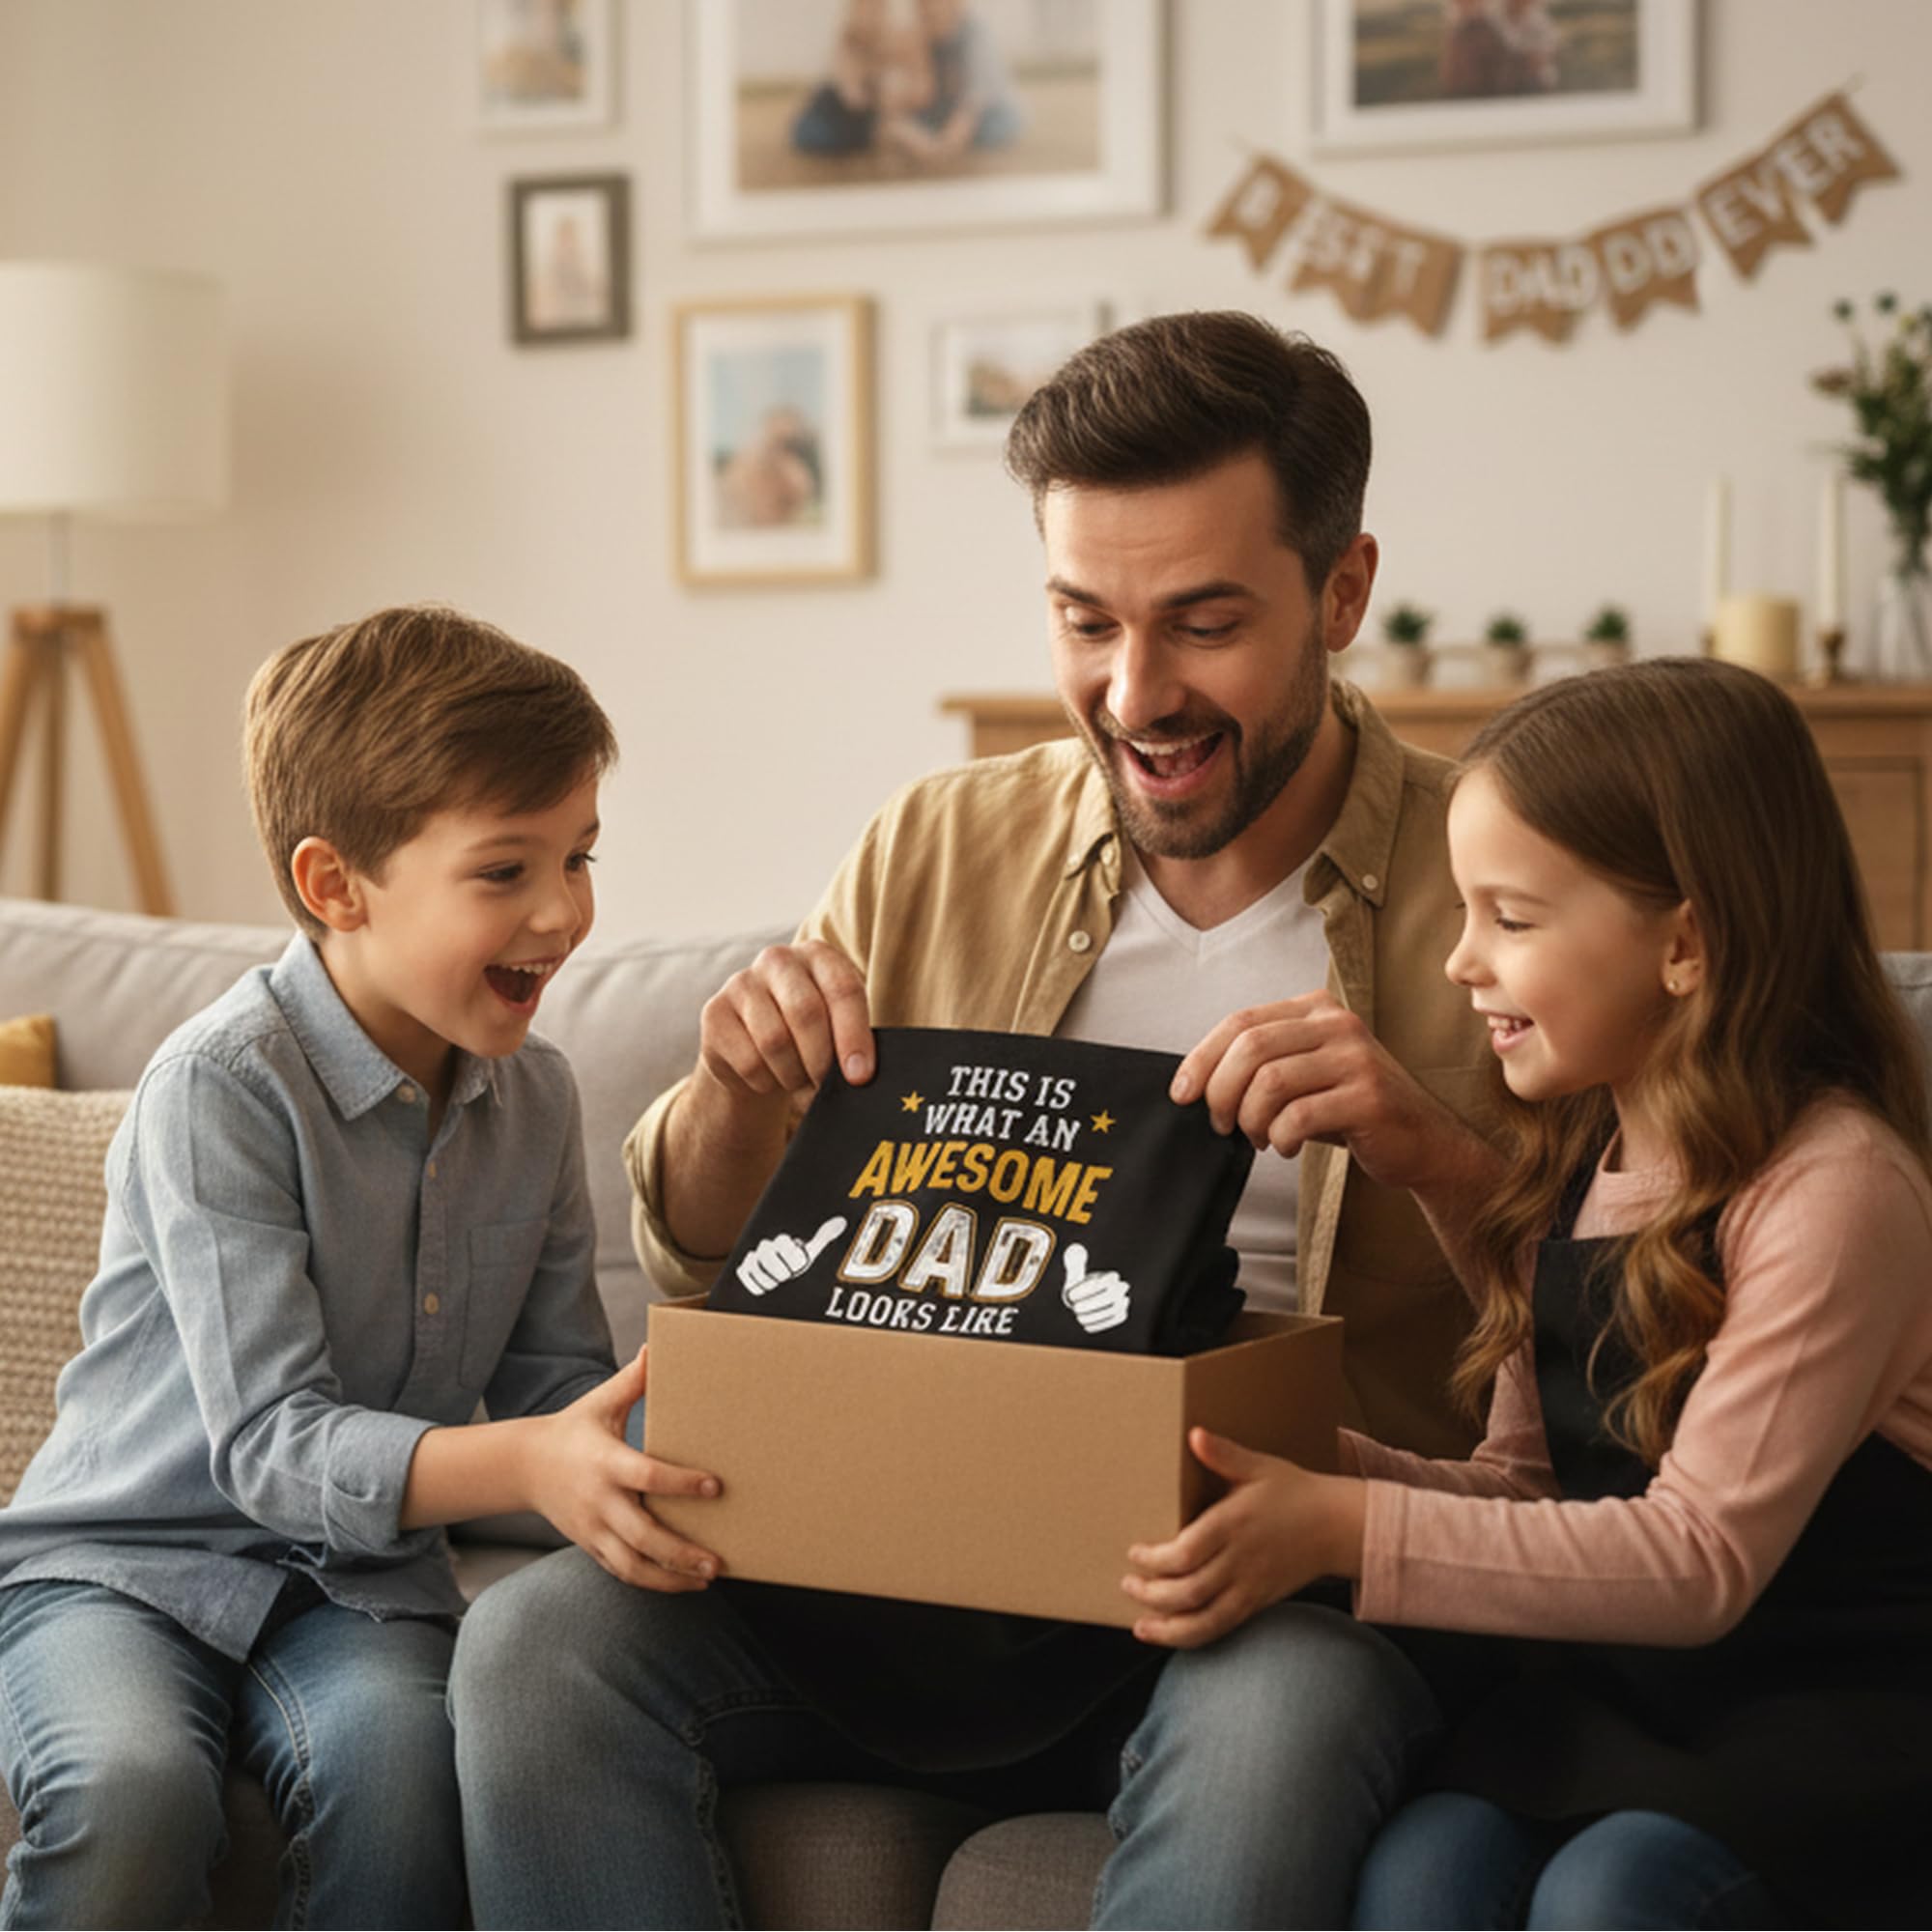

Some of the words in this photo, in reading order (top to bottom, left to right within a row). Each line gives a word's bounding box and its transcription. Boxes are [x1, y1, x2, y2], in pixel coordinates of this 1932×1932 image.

[1706, 112, 1862, 243] EVER
[924, 1102, 1023, 1139] WHAT
[1024, 1114, 1081, 1151] AN
[948, 1065, 1030, 1102] THIS
[1034, 1076, 1076, 1109] IS
[848, 1140, 1113, 1225] AWESOME
[837, 1198, 1057, 1303] DAD
